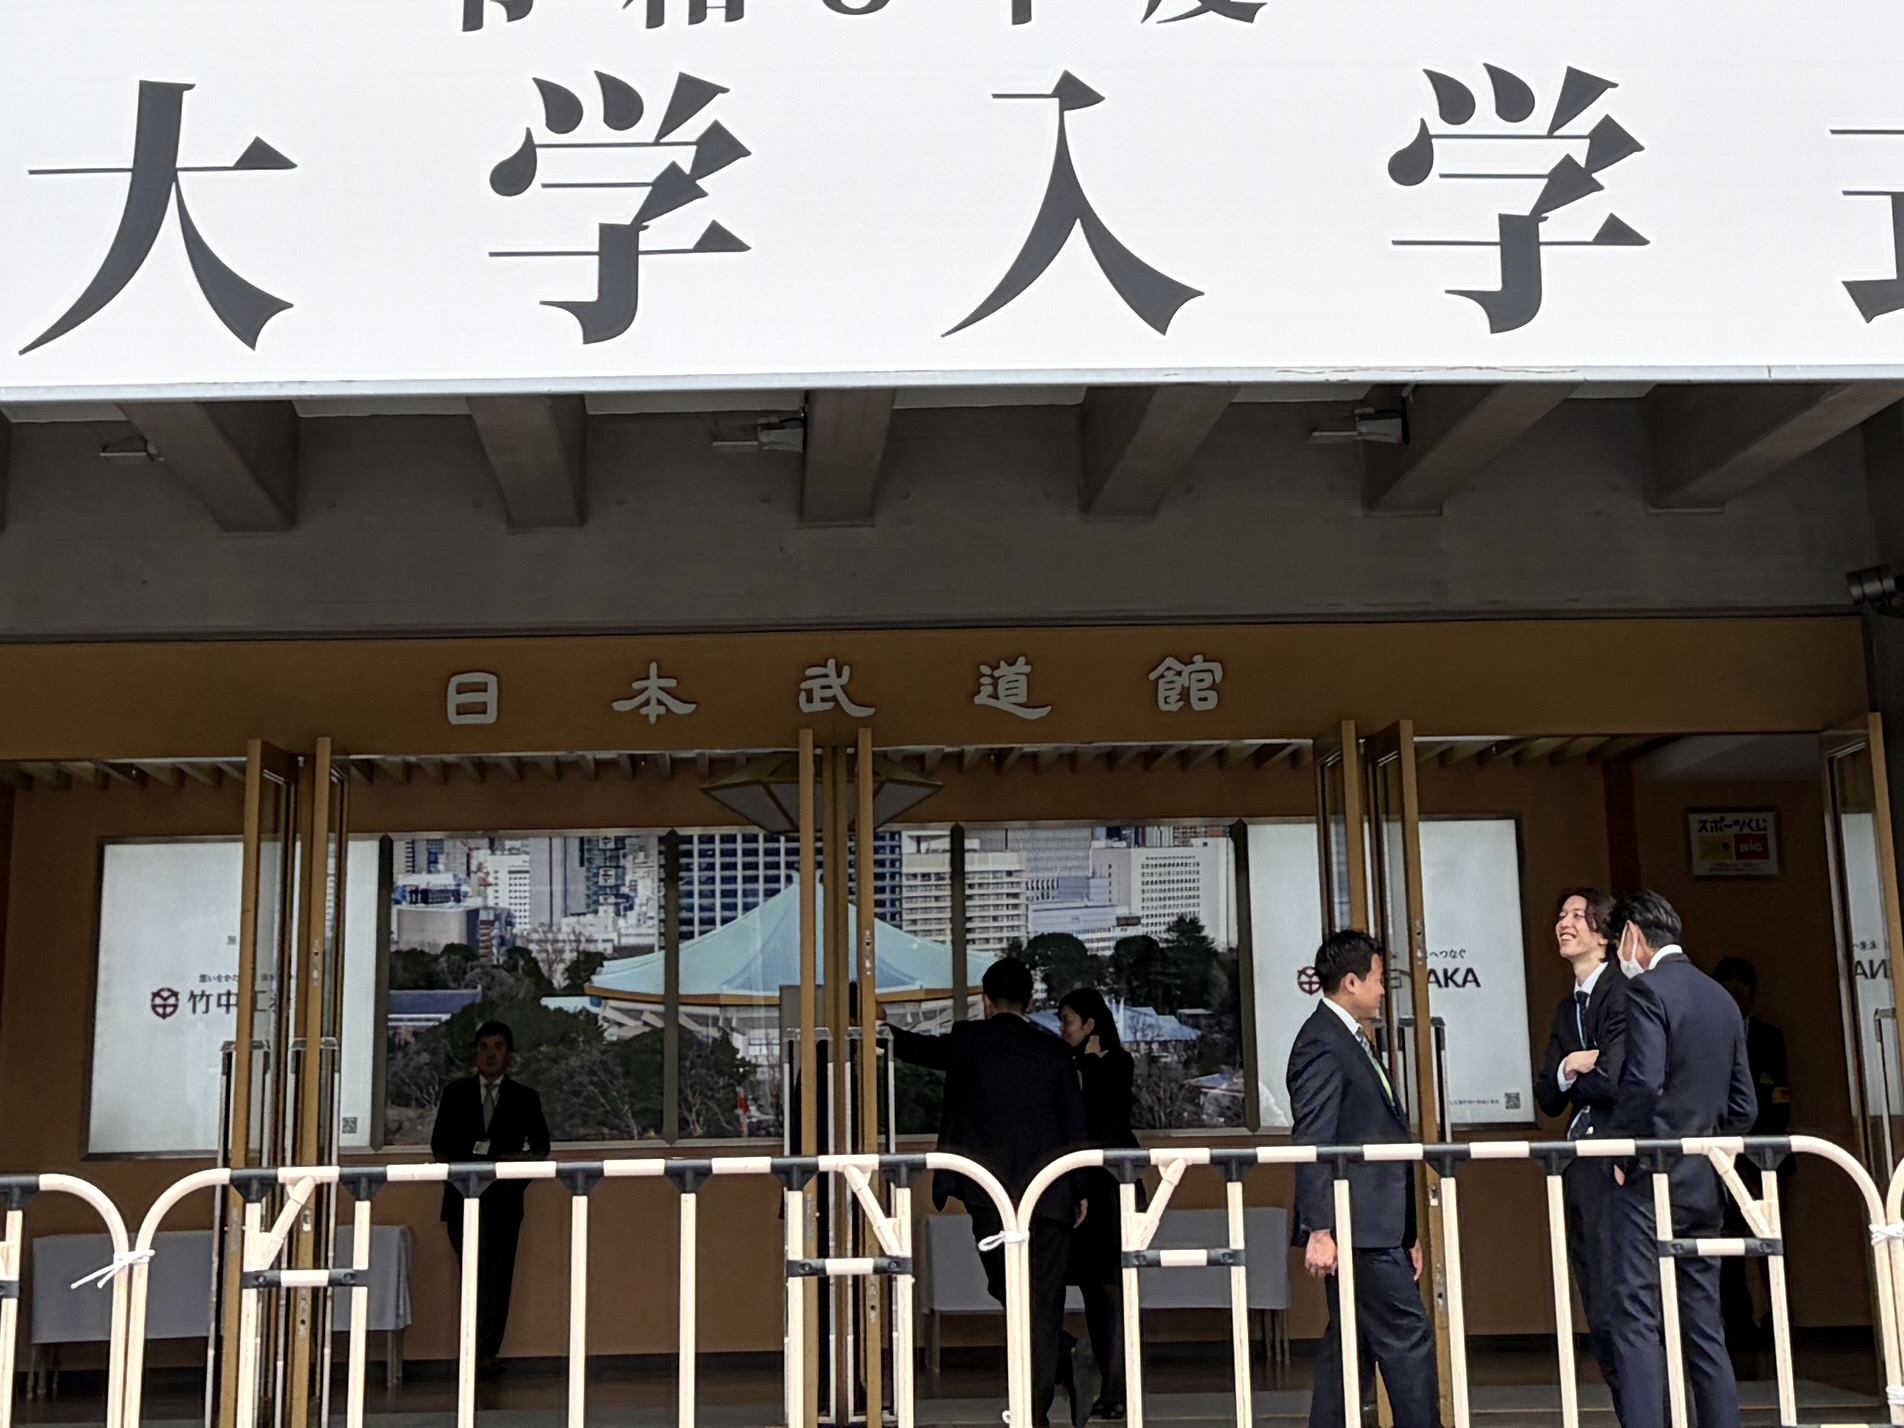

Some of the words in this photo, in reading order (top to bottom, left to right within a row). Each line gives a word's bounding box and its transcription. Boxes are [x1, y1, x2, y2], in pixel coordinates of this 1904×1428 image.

[445, 654, 1225, 726] 日本武道館
